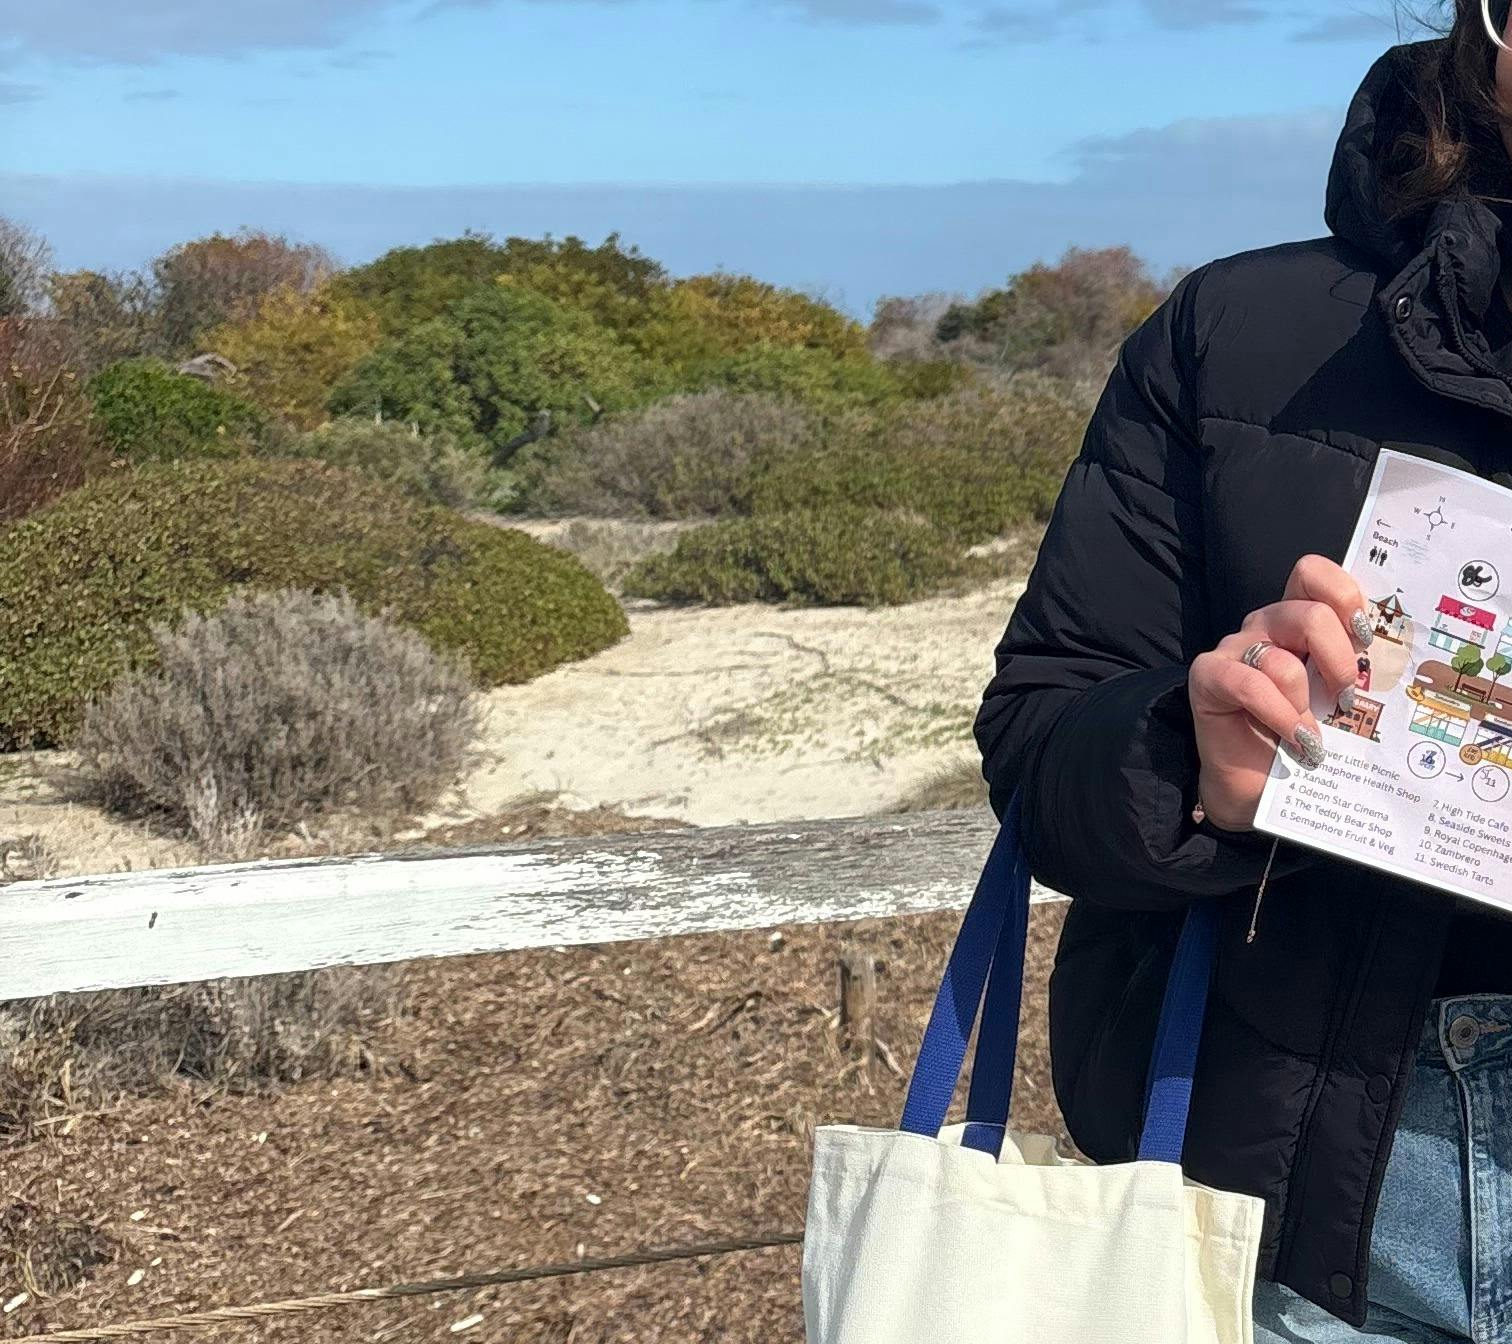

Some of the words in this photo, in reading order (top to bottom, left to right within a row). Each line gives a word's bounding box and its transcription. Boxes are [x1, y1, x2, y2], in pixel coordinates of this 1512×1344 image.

[1373, 531, 1398, 547] Beach
[1293, 768, 1302, 778] 3.
[1303, 771, 1339, 790] Xanadu
[1307, 757, 1361, 782] Semaphore
[1363, 775, 1394, 794] Health
[1396, 787, 1421, 803] Shop
[1344, 755, 1370, 770] Little
[1370, 763, 1401, 781] Picnic
[1485, 777, 1497, 788] 11
[1285, 795, 1293, 805] 5.
[1295, 797, 1312, 811] The
[1315, 804, 1342, 823] Teddy
[1344, 814, 1366, 828] Bear
[1367, 822, 1392, 838] Shop
[1298, 784, 1330, 803] Odeon
[1332, 796, 1352, 809] Star
[1353, 803, 1389, 821] Cinema
[1280, 809, 1288, 819] 6.
[1290, 811, 1343, 837] Semaphore
[1344, 830, 1367, 846] Fruit
[1368, 838, 1376, 847] &
[1378, 841, 1395, 856] Veg
[1427, 813, 1436, 824] 8.
[1438, 816, 1476, 836] Seaside
[1476, 829, 1511, 848] Sweets
[1441, 803, 1463, 817] High
[1466, 810, 1486, 824] Tide
[1487, 818, 1509, 833] Cafe
[1423, 825, 1432, 836] 9.
[1434, 829, 1461, 846] Royal
[1418, 839, 1433, 851] 10.
[1434, 844, 1481, 867] Zambrero
[1429, 857, 1469, 877] Swedish
[1471, 870, 1494, 886] Tarts
